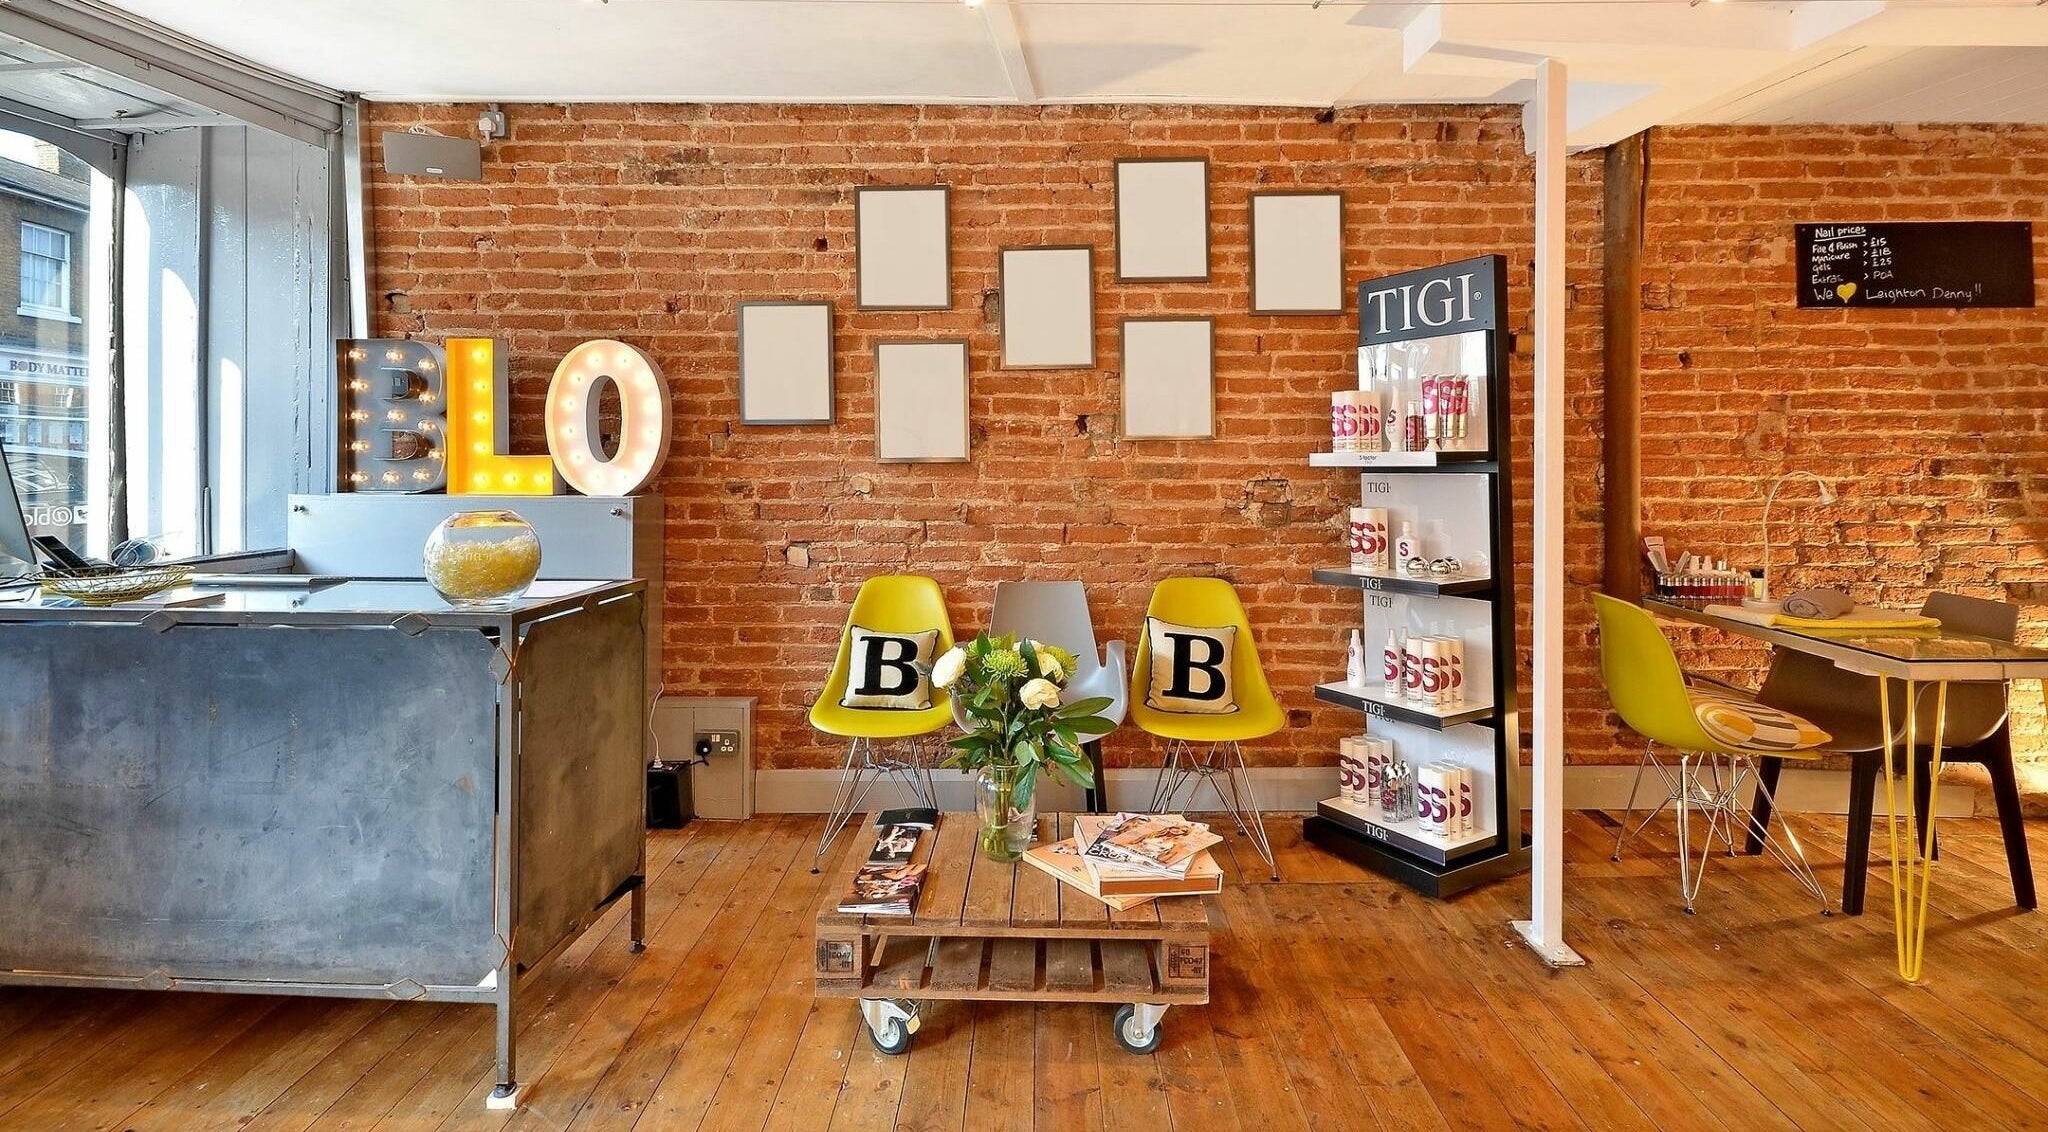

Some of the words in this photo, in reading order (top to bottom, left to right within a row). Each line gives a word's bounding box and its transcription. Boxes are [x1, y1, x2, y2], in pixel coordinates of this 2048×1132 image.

[1814, 227, 1835, 239] Nail
[1837, 226, 1867, 237] prices
[1871, 247, 1892, 258] £18
[1872, 257, 1892, 267] £25
[1813, 287, 1834, 300] We
[1866, 288, 1926, 304] Leighton
[10, 360, 43, 372] BODY
[1399, 541, 1409, 557] S
[854, 634, 919, 696] B
[1162, 632, 1226, 700] B
